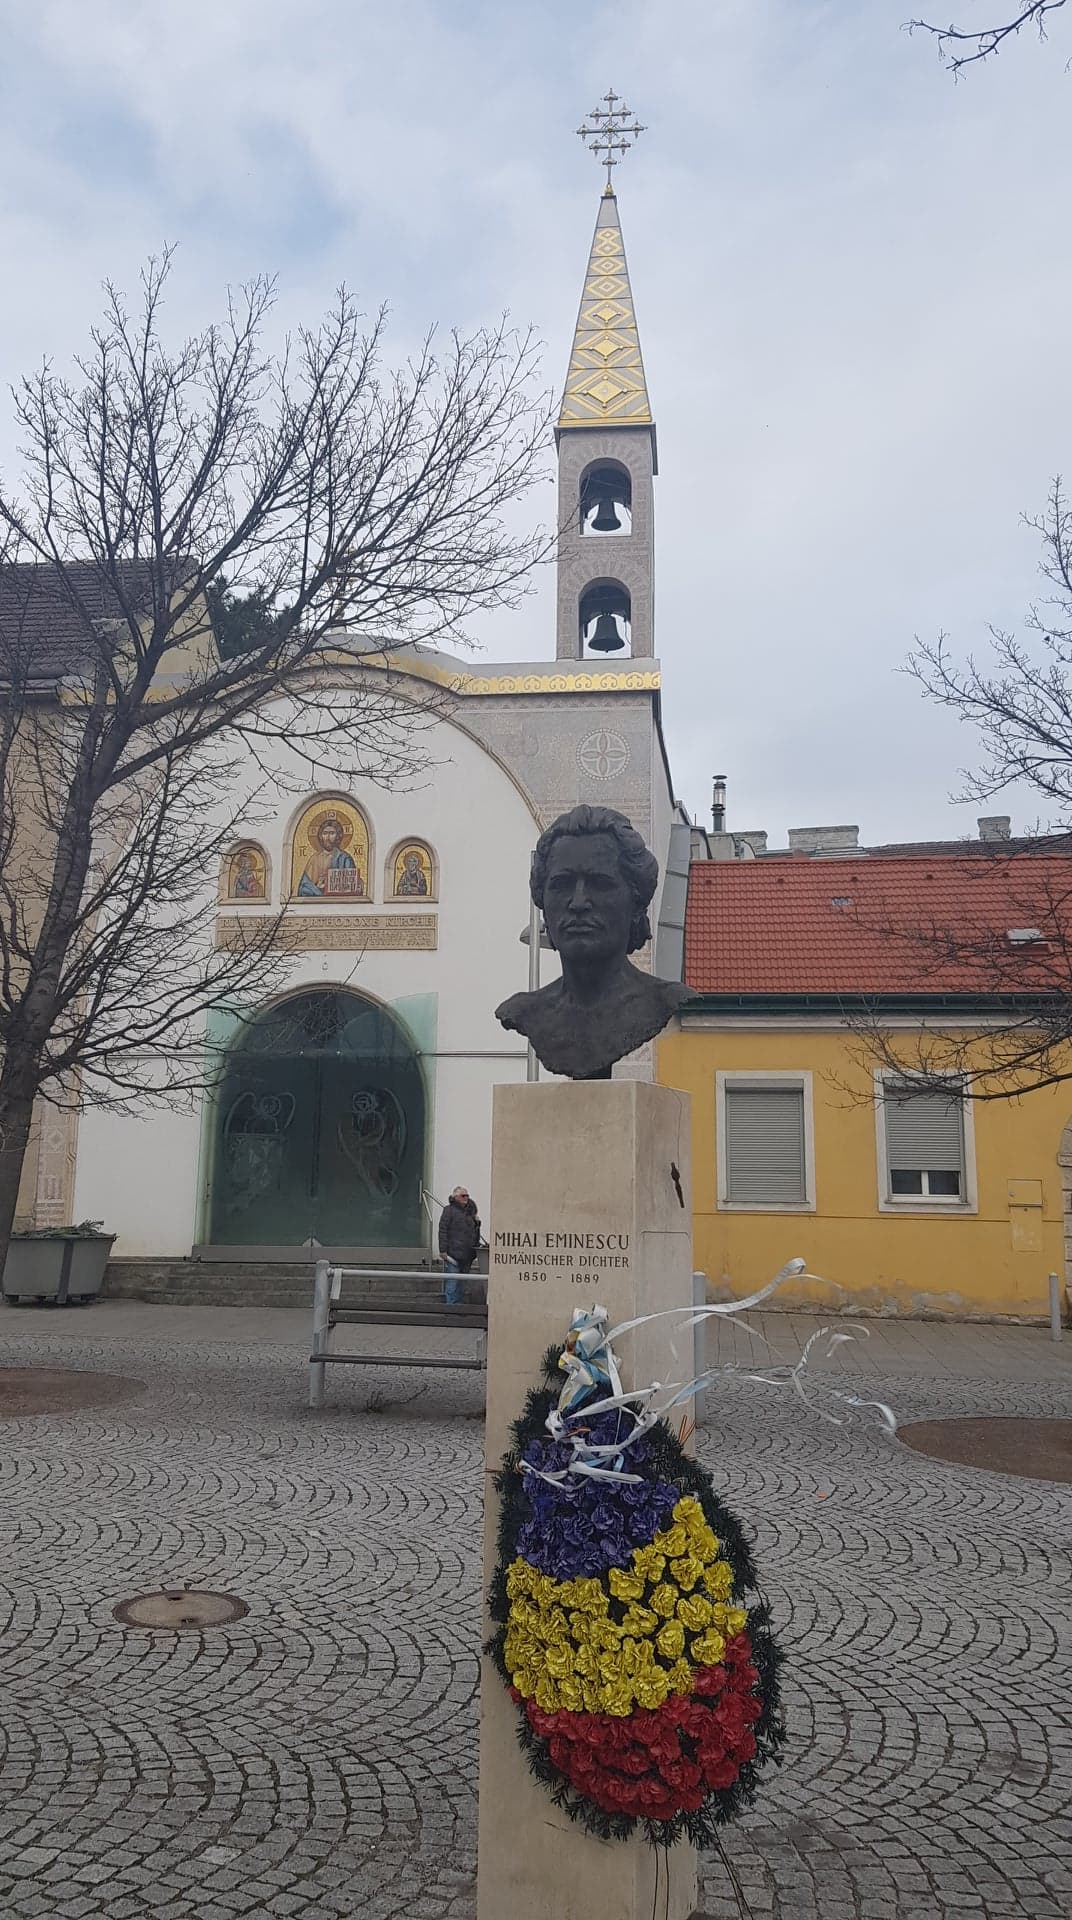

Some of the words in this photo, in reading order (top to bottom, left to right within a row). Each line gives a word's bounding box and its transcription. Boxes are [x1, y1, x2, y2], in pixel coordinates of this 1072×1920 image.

[385, 917, 433, 927] KIRCHE
[494, 1232, 537, 1247] MIHAI
[545, 1233, 630, 1250] EMINESCU
[494, 1251, 573, 1266] RUMÄNISCHER
[579, 1256, 629, 1268] DICHTER
[518, 1272, 547, 1282] 1850
[571, 1273, 599, 1284] 1889
